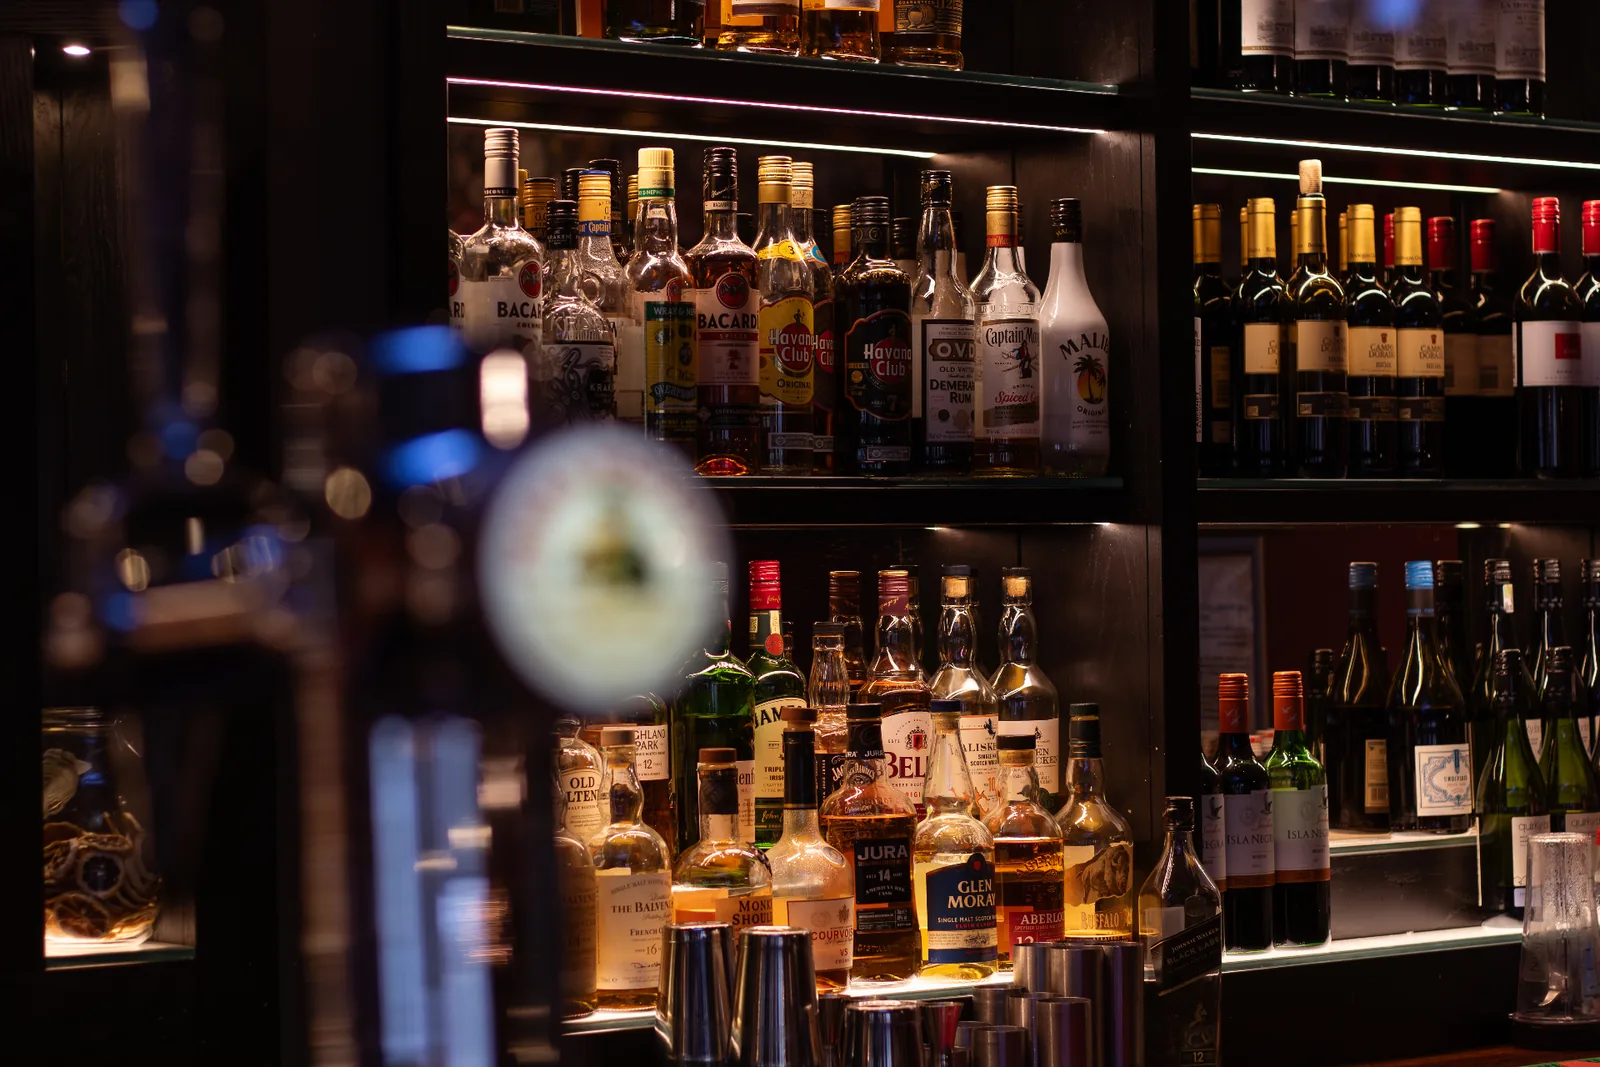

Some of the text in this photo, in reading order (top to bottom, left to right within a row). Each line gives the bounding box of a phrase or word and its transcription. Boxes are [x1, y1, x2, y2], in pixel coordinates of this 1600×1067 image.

[986, 326, 1024, 348] Captain
[780, 346, 811, 362] Club
[876, 360, 906, 377] Club
[939, 366, 956, 374] OLD
[949, 391, 972, 405] RUM
[864, 749, 884, 758] JURA
[643, 758, 653, 770] 12
[569, 776, 595, 789] OLD
[1227, 834, 1249, 845] ISLA
[1286, 829, 1310, 840] ISLA
[857, 844, 909, 860] JURA
[878, 868, 891, 882] 14
[957, 878, 993, 894] GLEN
[611, 904, 633, 914] THE
[937, 916, 958, 924] SINGLE
[1080, 910, 1120, 931] BUFFALO
[646, 943, 658, 956] 16
[1166, 946, 1197, 965] BLACK
[1192, 1051, 1205, 1064] 12
